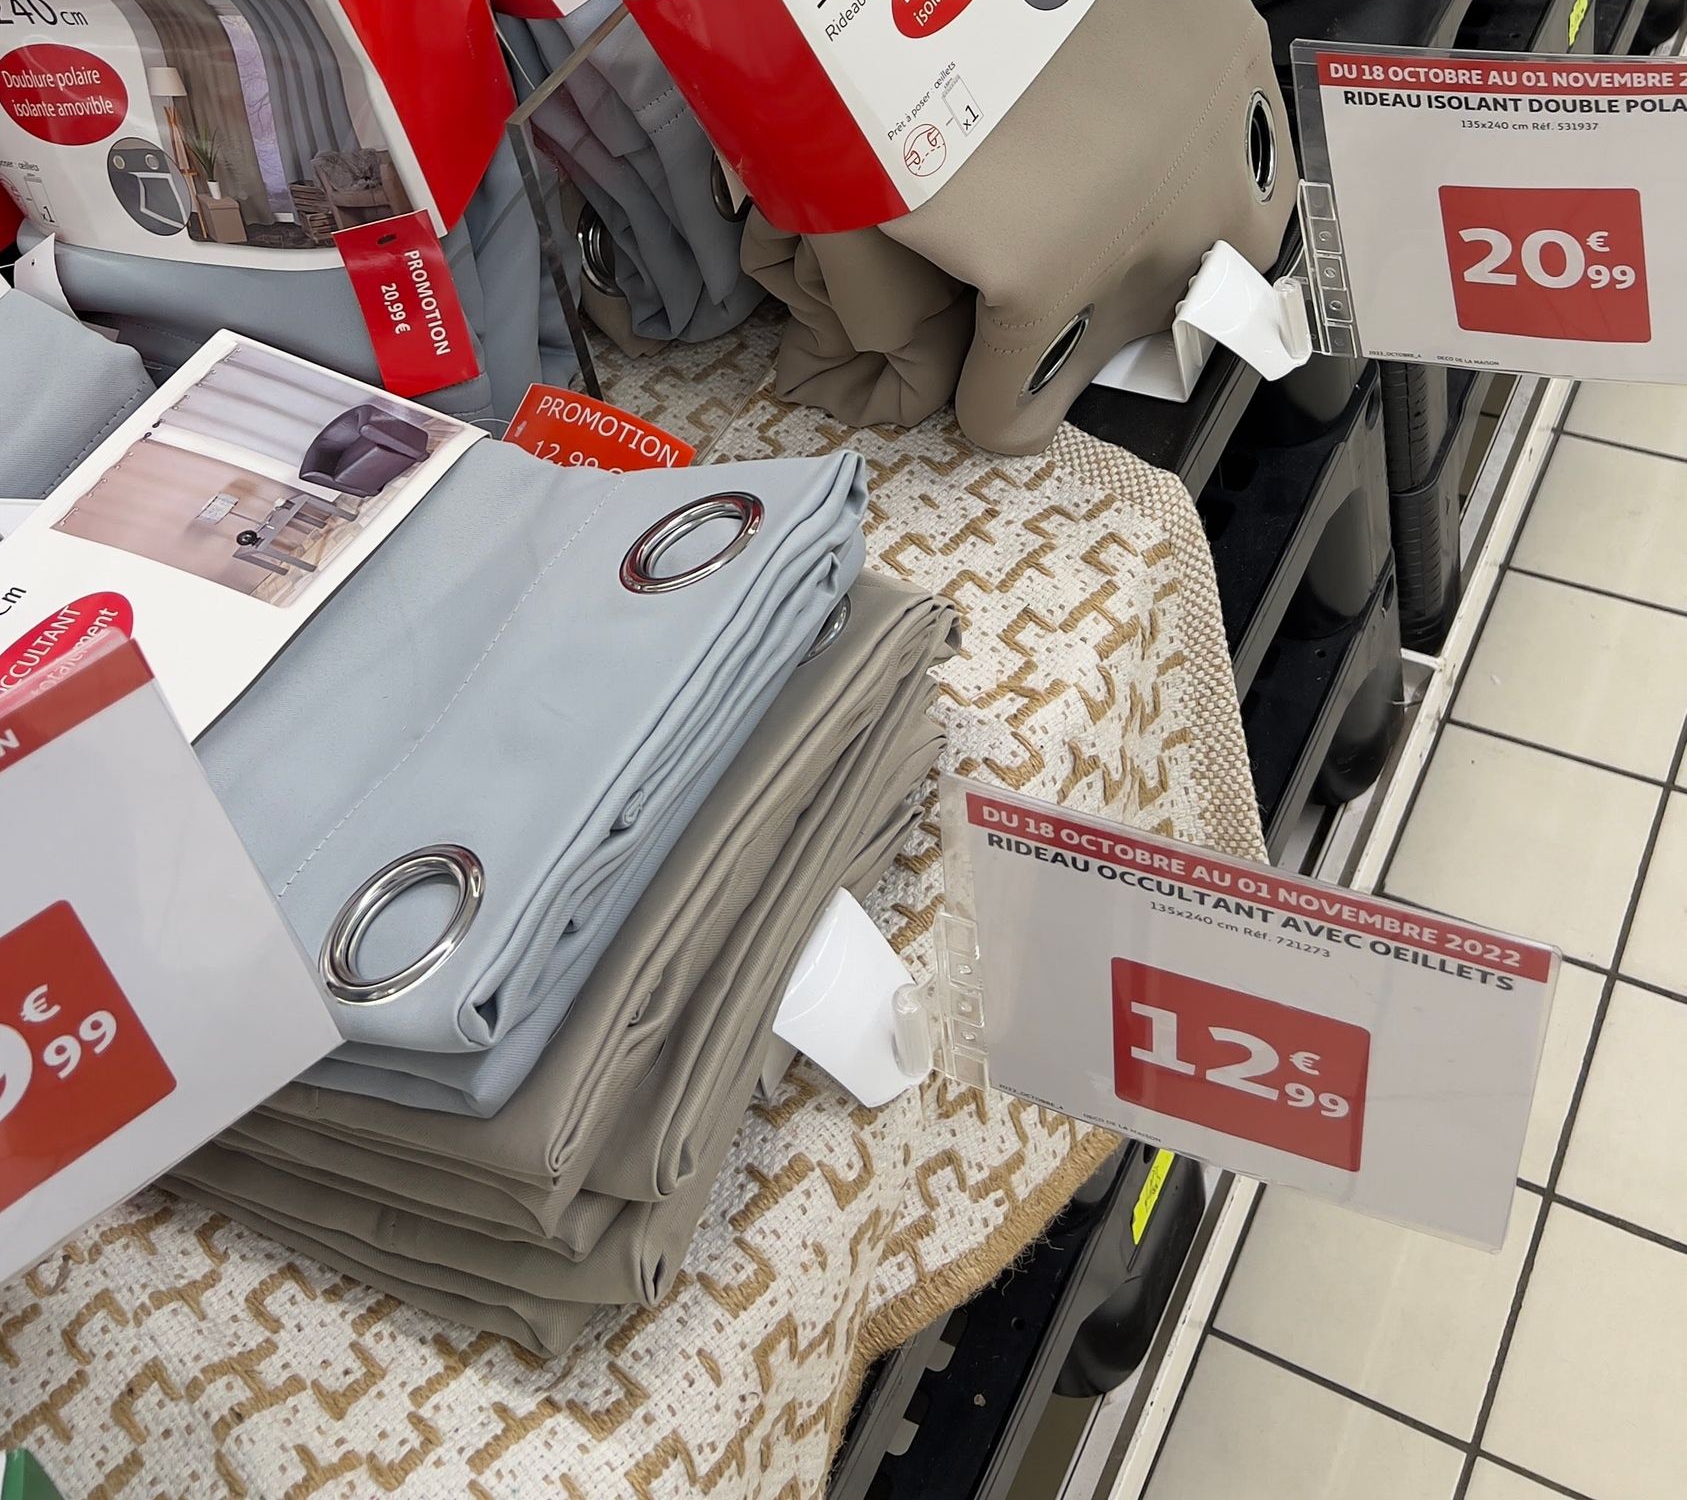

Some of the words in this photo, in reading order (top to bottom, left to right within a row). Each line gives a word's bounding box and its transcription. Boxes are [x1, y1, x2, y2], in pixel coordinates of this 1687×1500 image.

[2, 70, 54, 88] Doublure
[56, 66, 101, 91] polaire
[1329, 63, 1357, 79] DU
[1361, 65, 1385, 80] 18
[1388, 66, 1483, 85] OCTOBRE
[1488, 71, 1517, 86] AU
[1522, 71, 1548, 87] 01
[1552, 72, 1674, 88] NOVEMBRE
[12, 100, 56, 117] isolante
[57, 95, 114, 116] amovible
[887, 120, 906, 141] Prêt
[906, 113, 912, 123] à
[912, 90, 931, 118] poser
[963, 105, 979, 130] x1
[1343, 91, 1421, 108] RIDEAU
[1427, 94, 1522, 113] ISOLANT
[1528, 98, 1620, 113] DOUBLE
[1461, 120, 1509, 130] 135x240
[1532, 121, 1554, 130] Réf.
[1557, 122, 1599, 131] 531937
[404, 249, 451, 356] PROMOTION
[536, 395, 681, 467] PROMOTION
[0, 605, 81, 692] CCULTANT
[982, 805, 1018, 827] DU
[1025, 818, 1055, 838] 18
[1060, 828, 1187, 876] OCTOBRE
[1191, 865, 1232, 887] AU
[1238, 877, 1271, 899] 01
[1278, 887, 1438, 945] NOVEMBRE
[1444, 933, 1521, 968] 2022
[987, 832, 1090, 873] RIDEAU
[1097, 864, 1274, 924] OCCULTANT
[1281, 915, 1363, 949] AVEC
[1369, 939, 1515, 992] OEILLETS
[1150, 901, 1213, 926] 135x240
[1217, 921, 1239, 934] cm
[1243, 927, 1272, 943] Réf.
[1276, 936, 1331, 958] 721273
